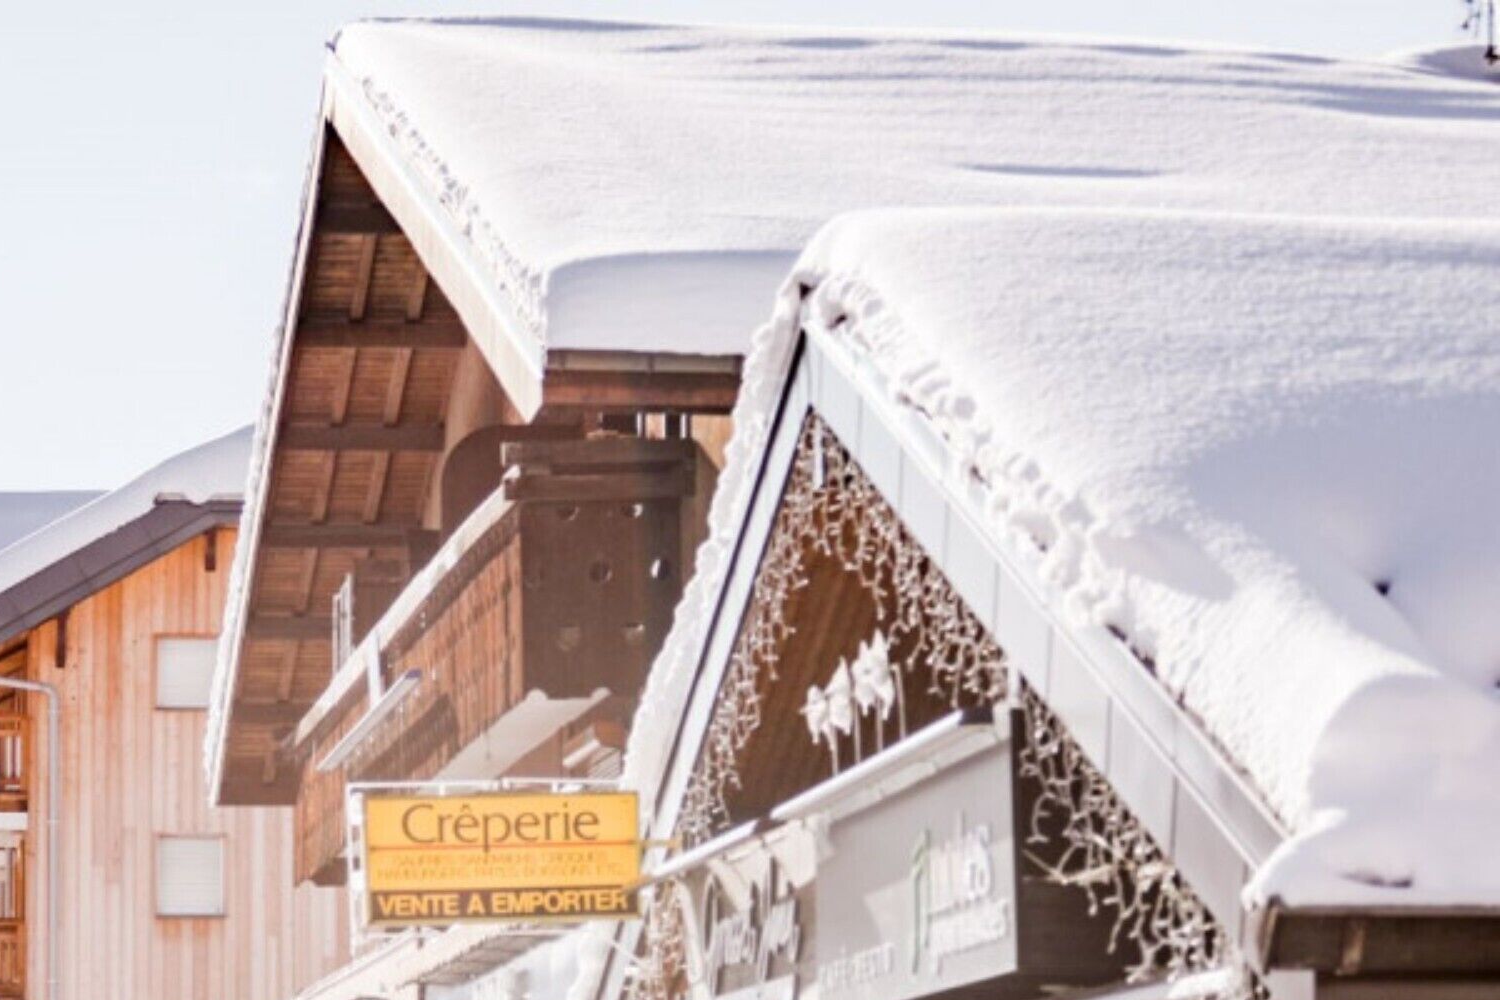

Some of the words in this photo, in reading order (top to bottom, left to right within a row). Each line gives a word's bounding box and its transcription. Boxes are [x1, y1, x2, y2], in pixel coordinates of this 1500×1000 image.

[402, 801, 599, 853] Crêperie
[379, 894, 458, 916] VENTE
[467, 894, 486, 915] A
[491, 889, 628, 915] EMPORTER
